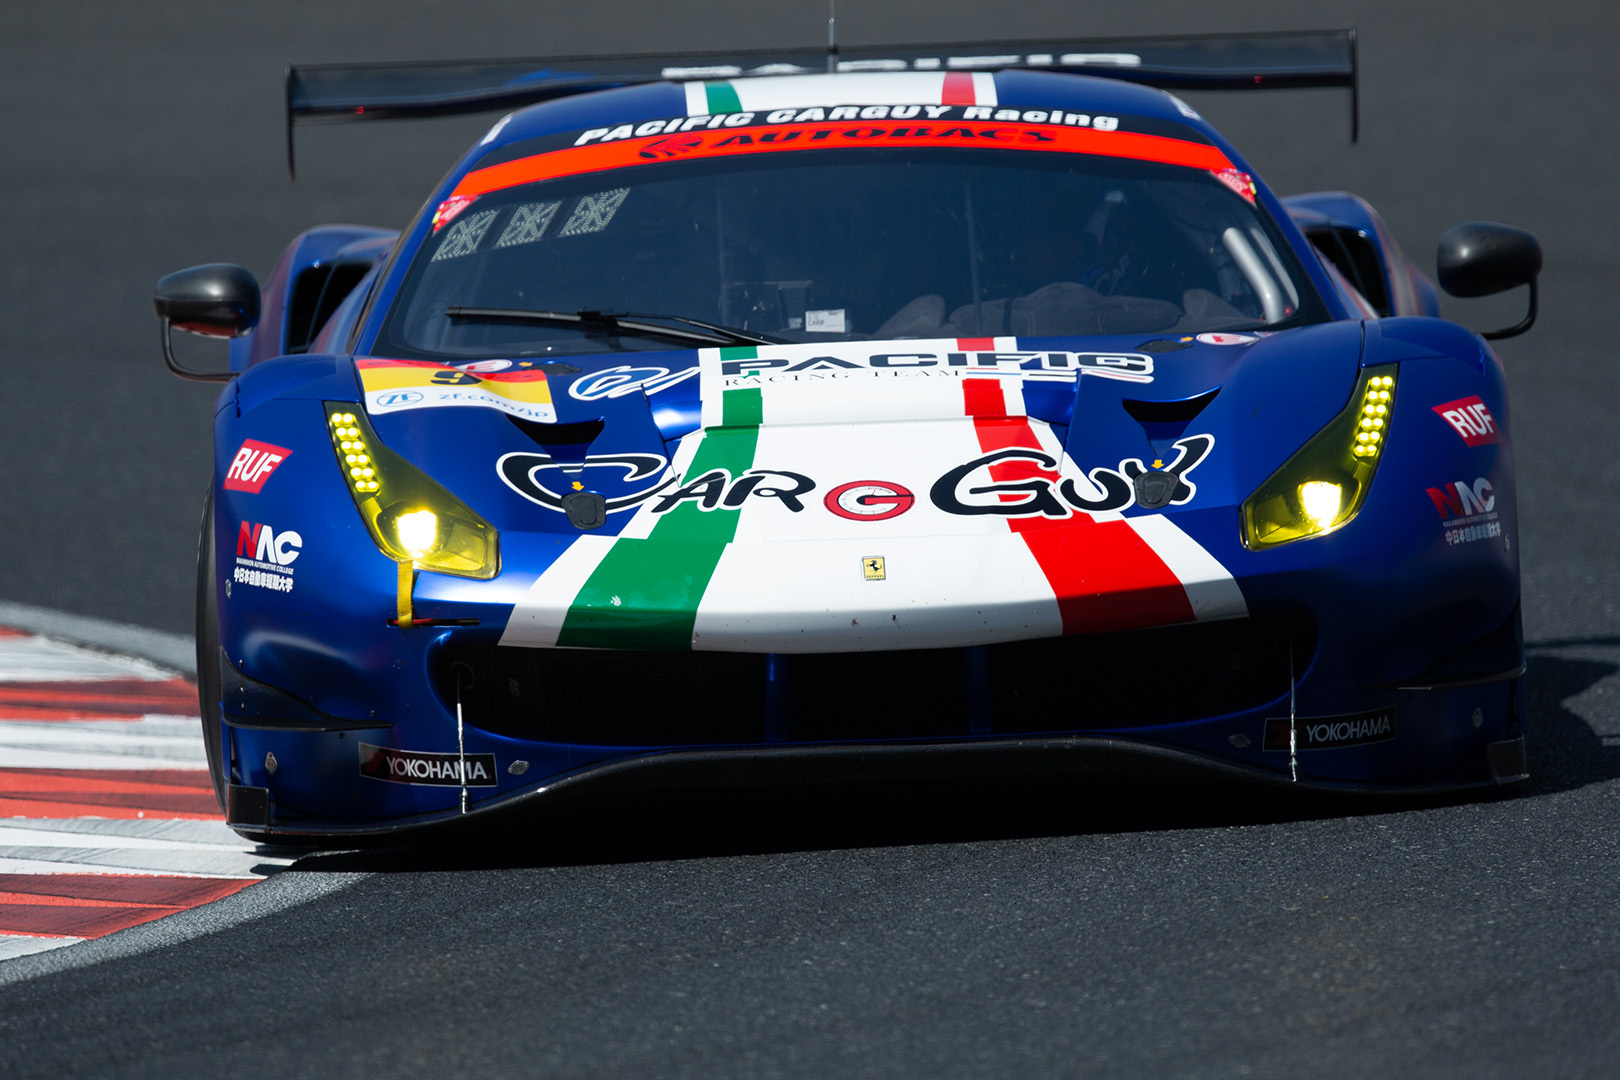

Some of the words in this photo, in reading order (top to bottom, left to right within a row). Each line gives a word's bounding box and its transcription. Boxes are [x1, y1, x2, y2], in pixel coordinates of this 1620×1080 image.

[573, 112, 755, 147] PACIFIC
[765, 104, 953, 124] CARGUY
[962, 105, 1120, 132] Racing
[709, 126, 1056, 148] AUTOBACS
[720, 351, 1153, 376] PACIFIC
[724, 372, 851, 387] RACING
[867, 369, 960, 379] TEAM
[1442, 402, 1495, 438] RUF
[227, 446, 283, 483] RUF
[1425, 477, 1496, 519] NAC
[236, 520, 303, 566] NAC
[1306, 715, 1391, 743] YOKOHAMA
[386, 756, 488, 780] YOKOHAMA
